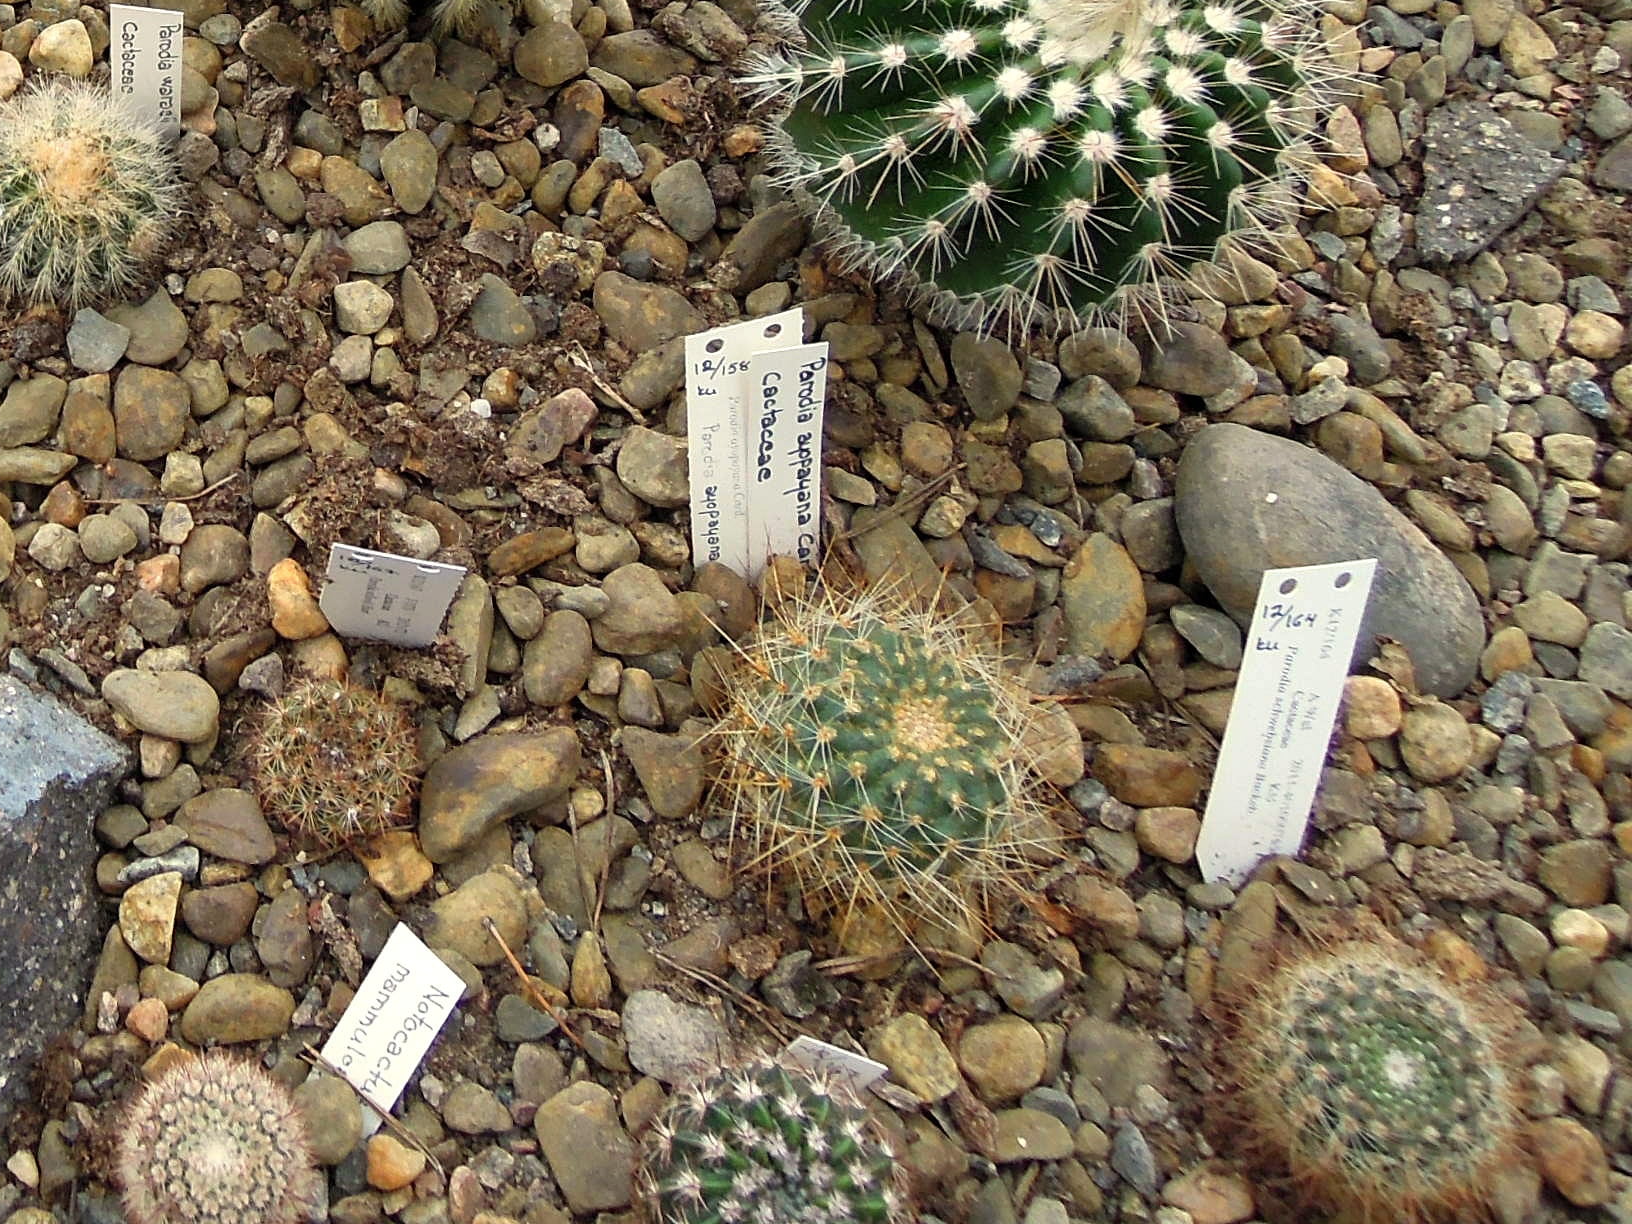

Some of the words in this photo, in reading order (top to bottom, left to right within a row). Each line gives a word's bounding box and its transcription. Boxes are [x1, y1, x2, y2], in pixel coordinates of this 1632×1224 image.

[121, 21, 142, 94] Cactaceae
[797, 356, 826, 424] Parodia
[757, 372, 784, 483] Cactaceae
